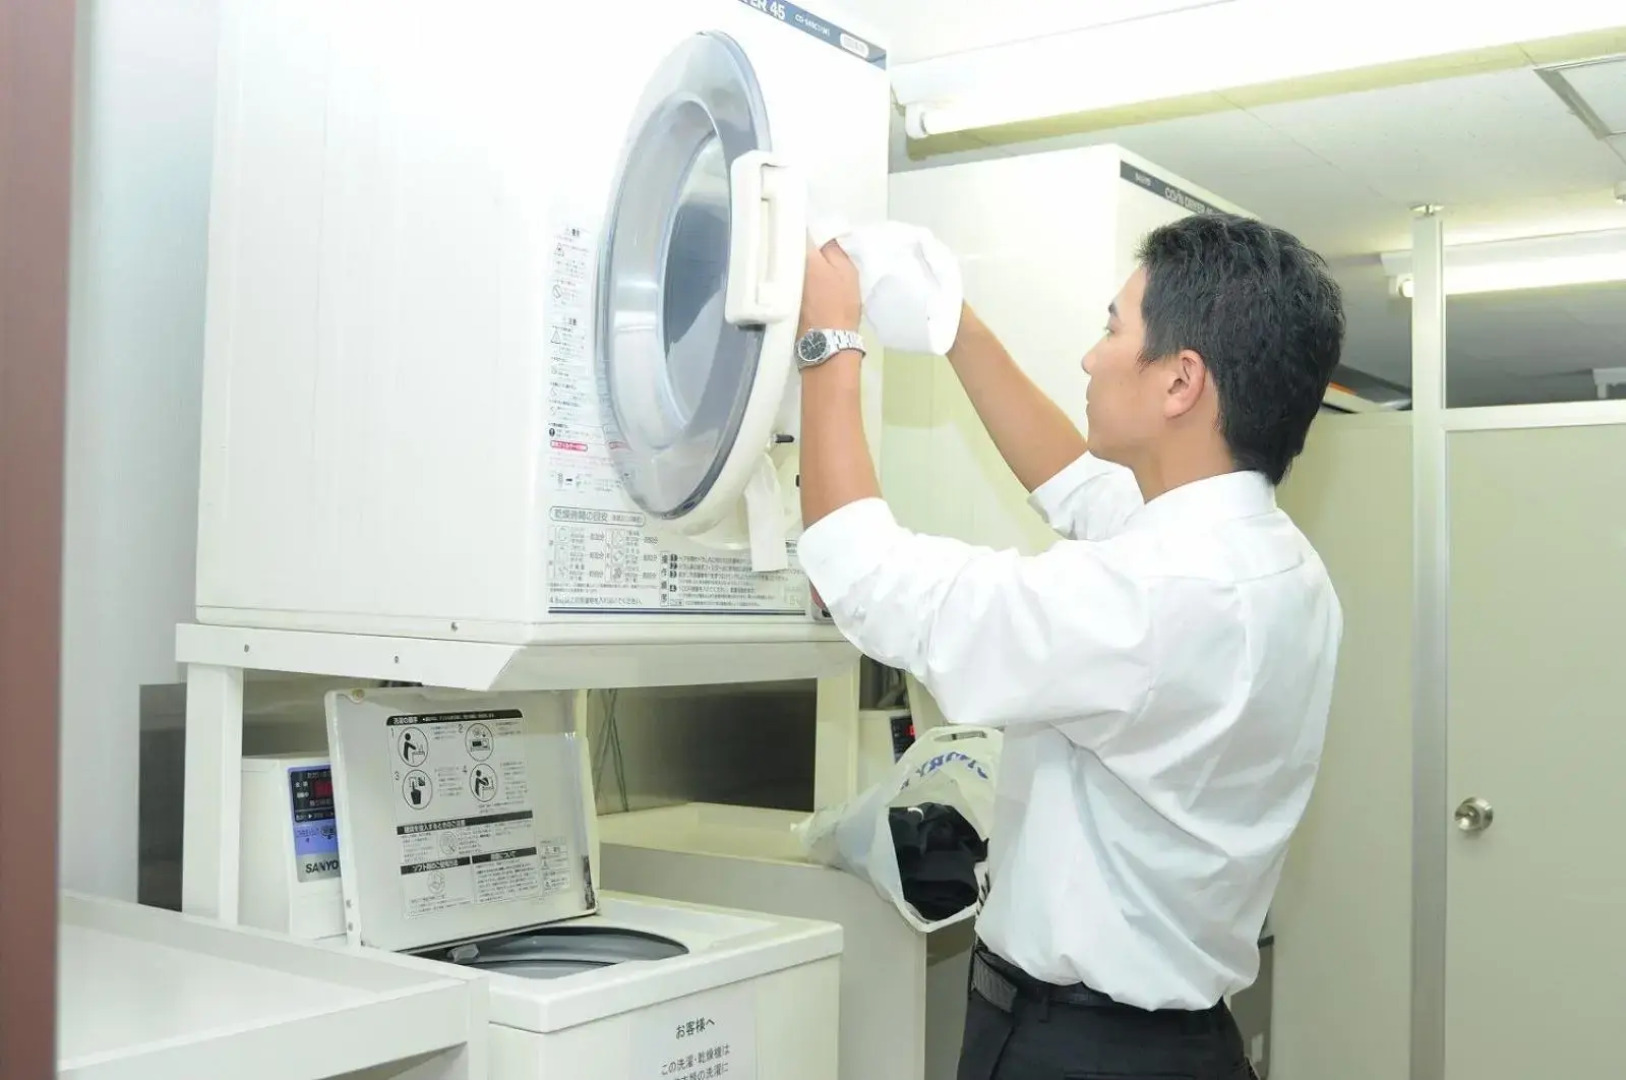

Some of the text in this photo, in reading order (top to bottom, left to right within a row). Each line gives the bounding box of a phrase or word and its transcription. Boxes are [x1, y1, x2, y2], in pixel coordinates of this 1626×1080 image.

[770, 1, 785, 20] 45
[305, 860, 339, 874] SANYO
[675, 1017, 715, 1039] お客様へ
